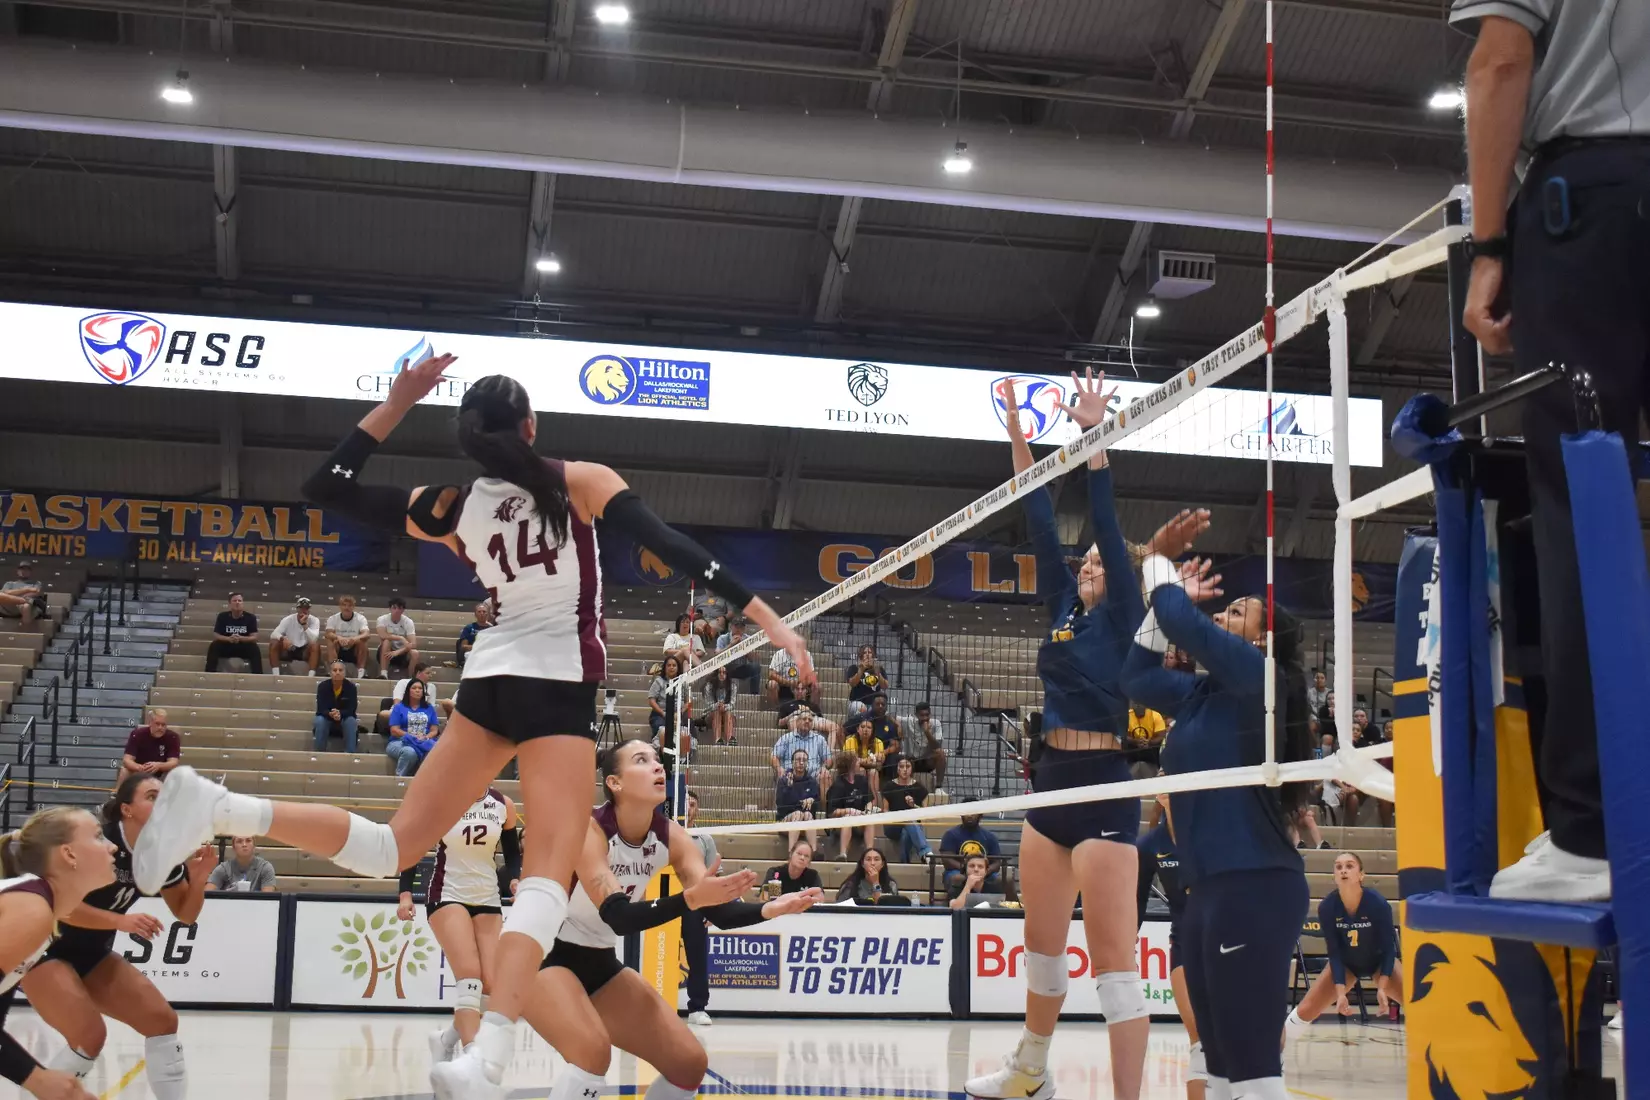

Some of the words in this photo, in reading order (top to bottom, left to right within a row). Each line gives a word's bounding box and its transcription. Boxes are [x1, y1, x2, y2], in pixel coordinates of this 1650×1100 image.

[164, 330, 266, 369] ASG
[1201, 355, 1219, 376] EAST
[1221, 338, 1245, 364] TEXAS
[1248, 325, 1265, 348] A&M
[643, 380, 699, 390] DALLAS/ROCKWALL
[653, 387, 688, 395] LAKEFRONT
[638, 397, 658, 405] LION
[660, 399, 707, 409] ATHLETICS
[824, 408, 859, 423] TED
[864, 411, 909, 426] LYON
[1129, 401, 1145, 419] EAST
[1146, 386, 1168, 409] TEXAS
[0, 492, 340, 543] ASKETBALL
[0, 531, 87, 557] AMENTS
[166, 539, 325, 569] ALL-AMERICANS
[486, 519, 559, 583] 14
[818, 543, 935, 589] GO
[967, 551, 1037, 594] LI
[461, 824, 488, 846] 12
[1346, 929, 1359, 947] 7
[1350, 921, 1372, 929] TEXAS
[123, 920, 199, 965] SG
[657, 930, 666, 961] sports
[786, 935, 856, 964] BEST
[861, 936, 944, 966] PLACE
[142, 969, 190, 978] STEMS
[713, 958, 769, 966] DALLAS/ROCKWALL
[788, 966, 822, 994] TO
[828, 966, 902, 995] STAY!
